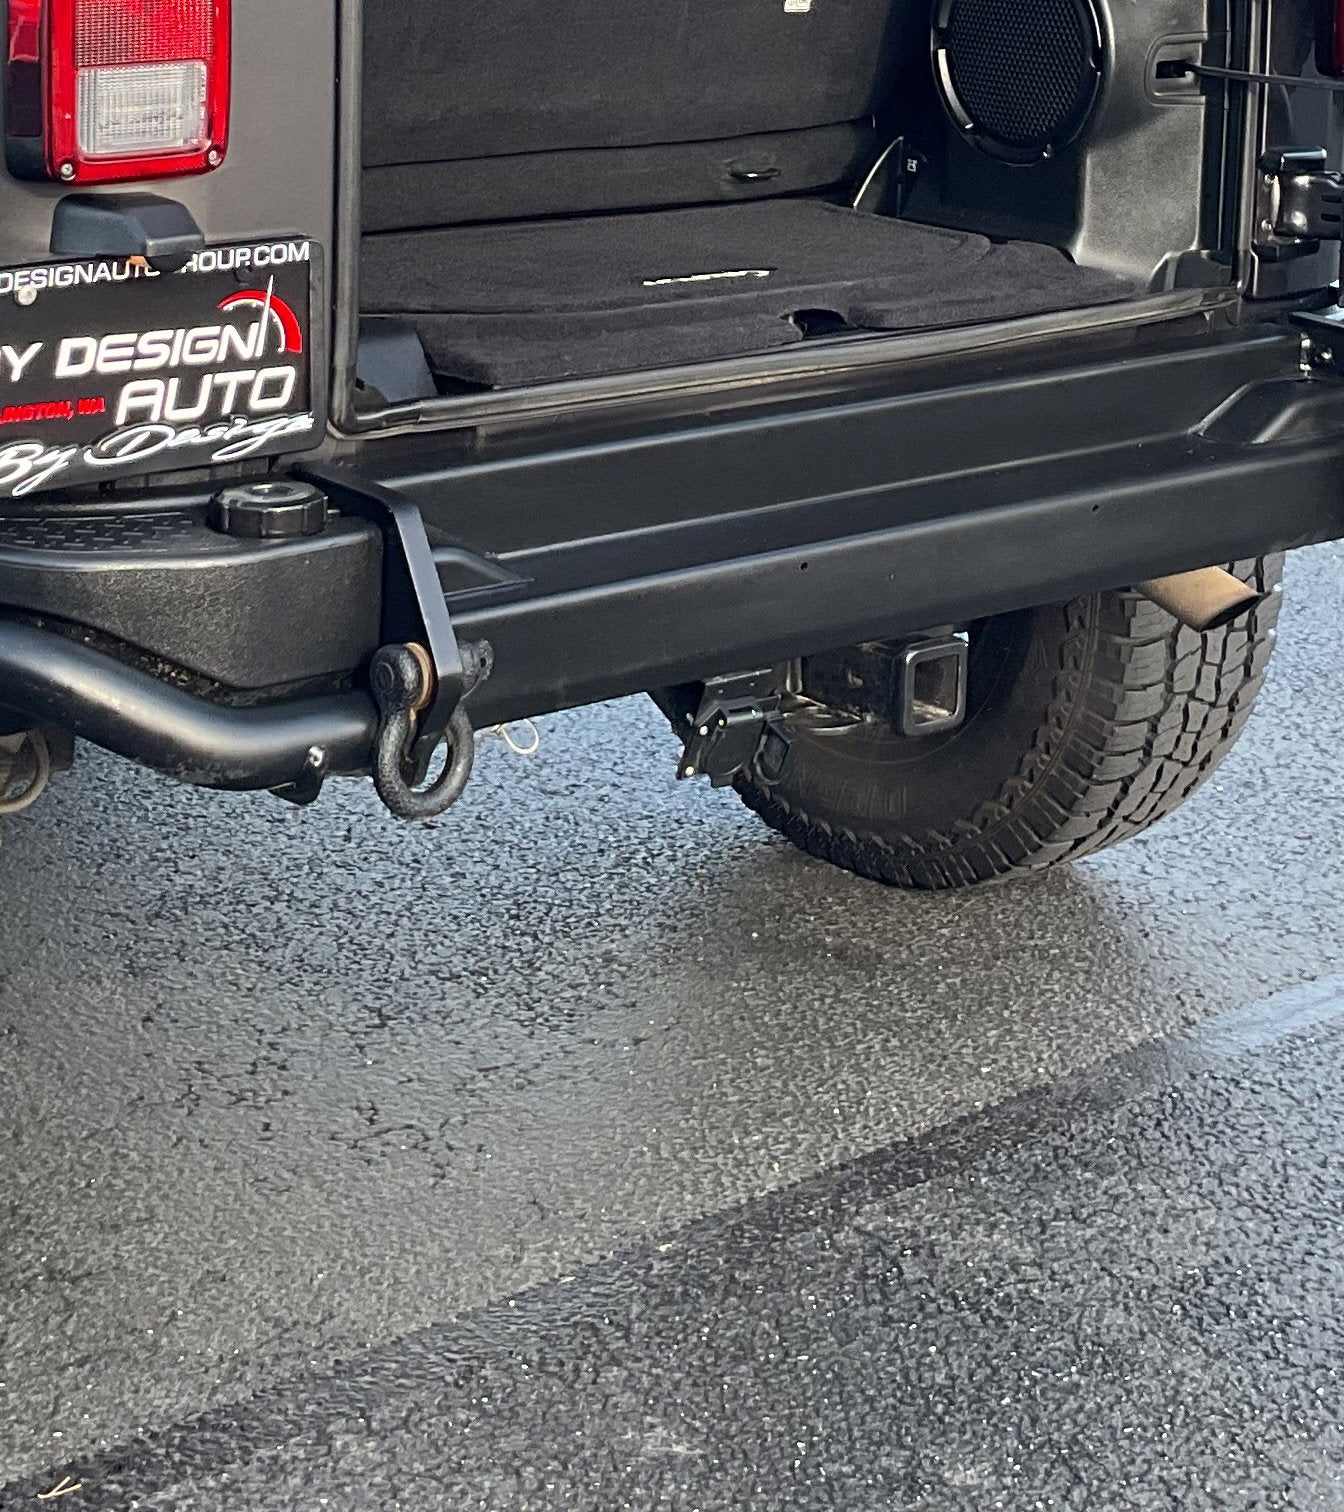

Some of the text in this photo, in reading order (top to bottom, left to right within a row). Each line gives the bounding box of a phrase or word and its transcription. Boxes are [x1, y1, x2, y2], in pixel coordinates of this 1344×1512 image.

[55, 321, 262, 378] DESIGN
[78, 396, 106, 415] WA
[114, 364, 297, 425] AUTO
